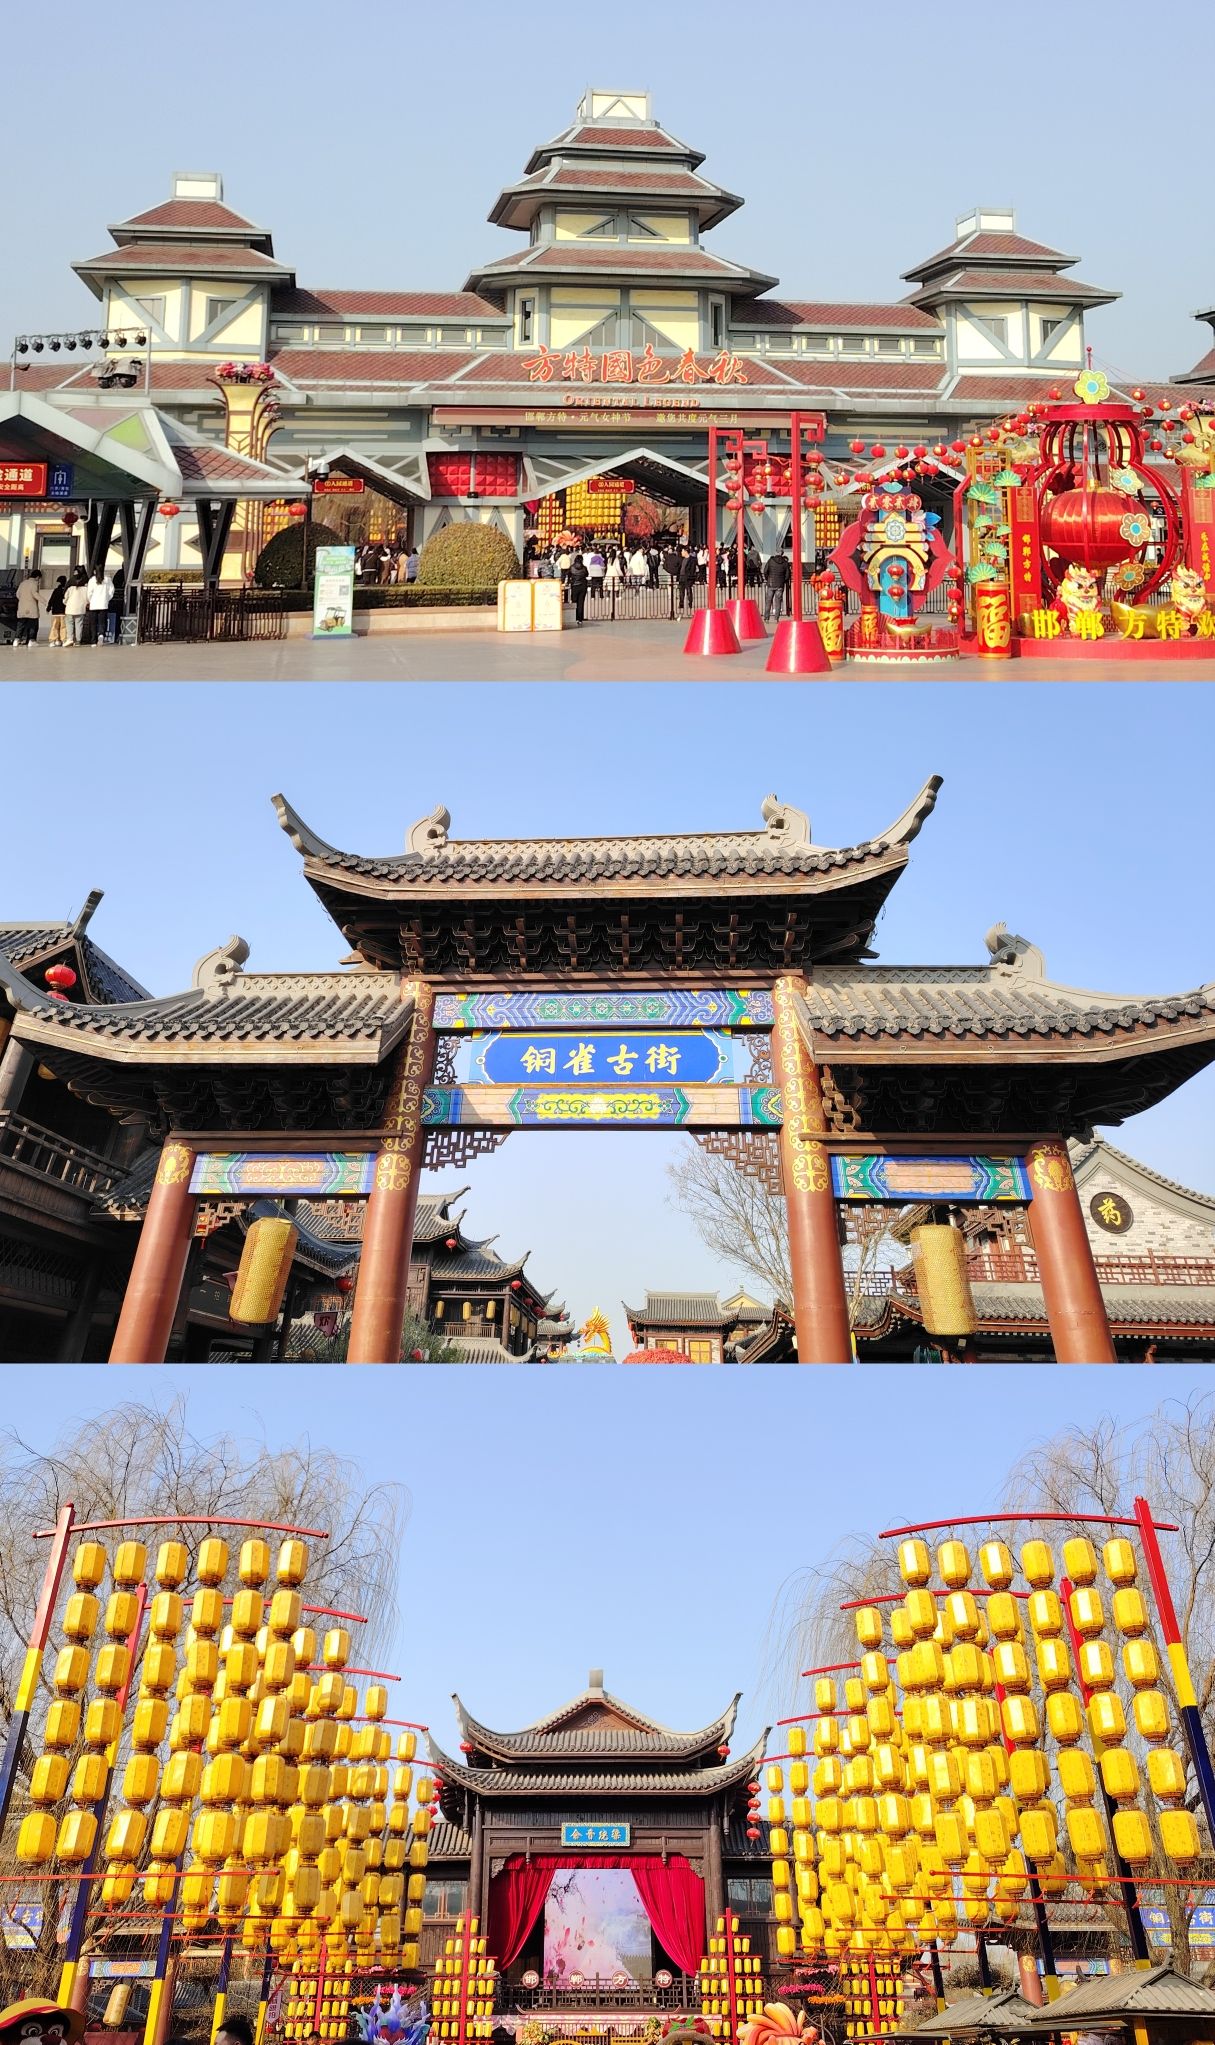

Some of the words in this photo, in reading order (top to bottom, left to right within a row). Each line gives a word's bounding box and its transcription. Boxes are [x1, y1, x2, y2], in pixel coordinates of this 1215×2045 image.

[521, 342, 748, 384] 方特國色春秋
[0, 468, 33, 482] 通道
[816, 608, 842, 652] 福
[978, 593, 1011, 649] 福
[520, 1042, 682, 1076] 铜雀古街
[1097, 1197, 1122, 1226] 药
